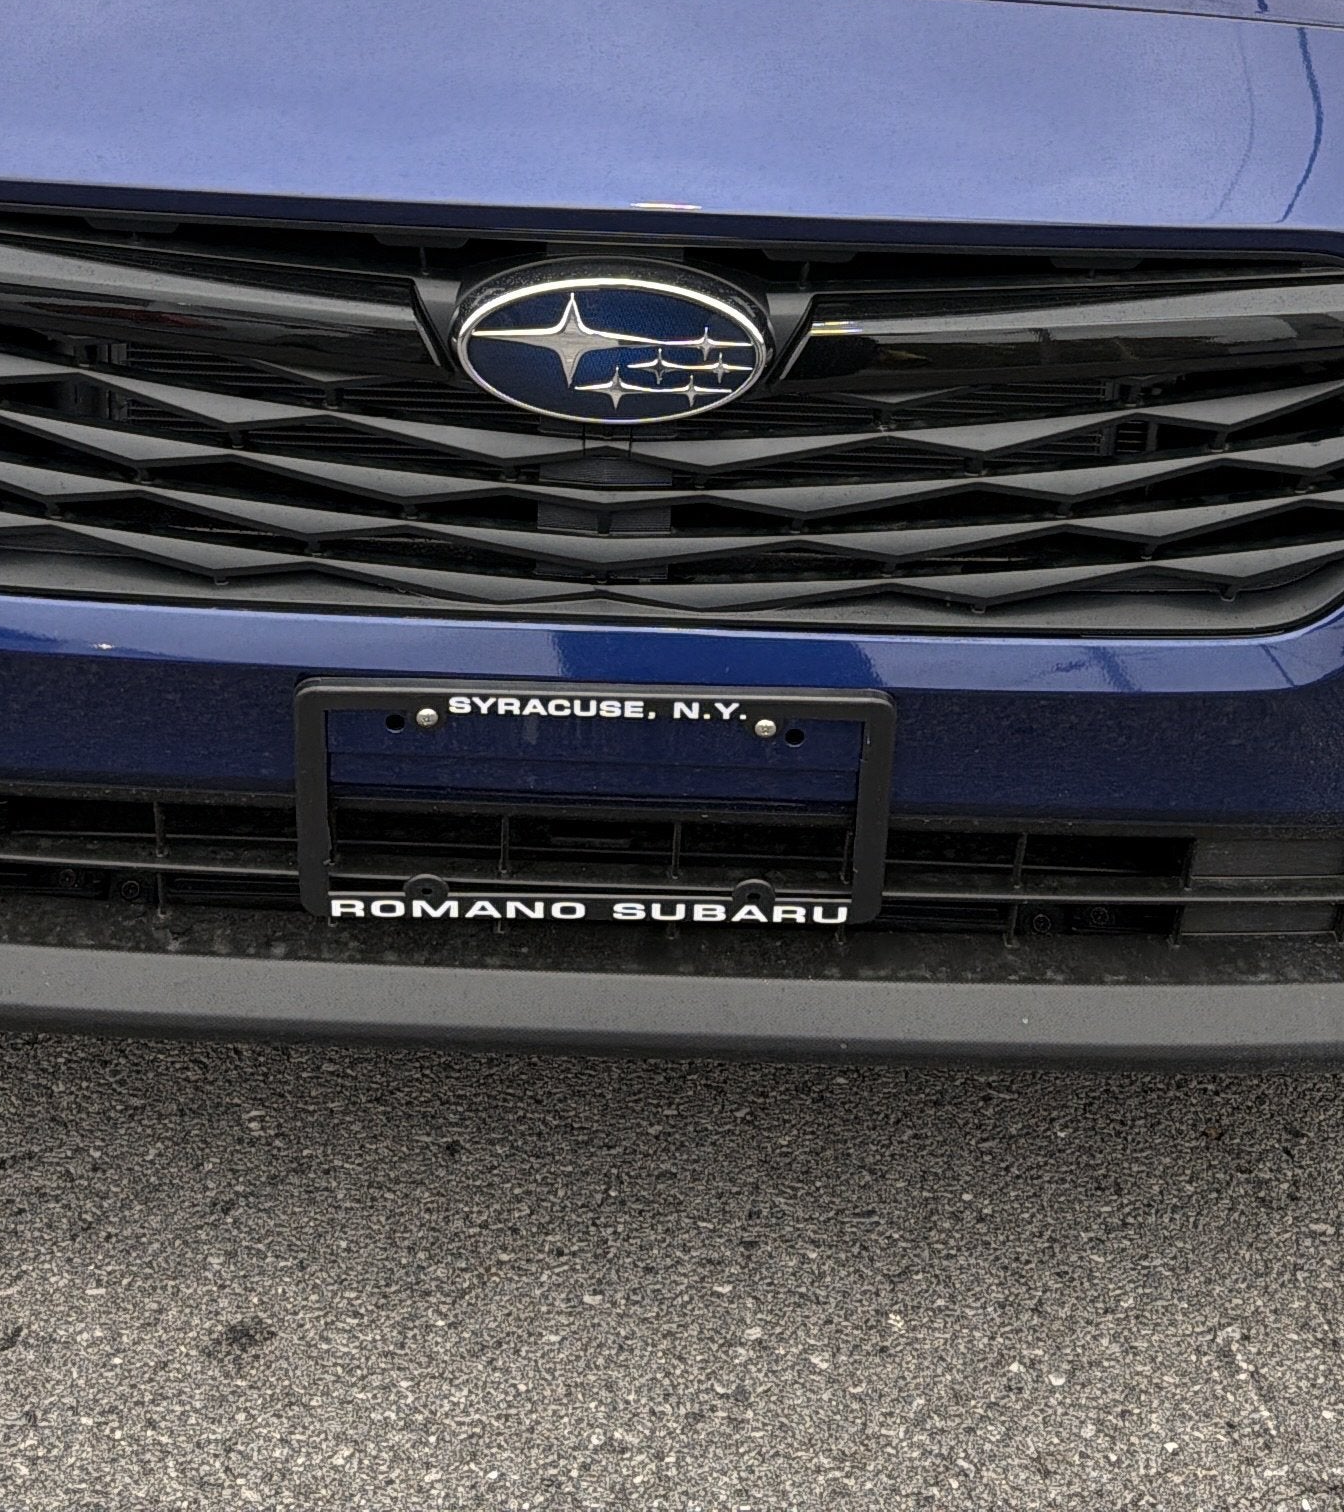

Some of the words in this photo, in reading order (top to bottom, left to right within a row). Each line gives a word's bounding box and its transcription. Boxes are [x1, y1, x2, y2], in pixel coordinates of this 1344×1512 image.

[448, 695, 656, 720] SYRACUSE,
[672, 702, 748, 721] N.Y.
[330, 899, 586, 920] ROMANO
[612, 902, 849, 925] SUBARU
